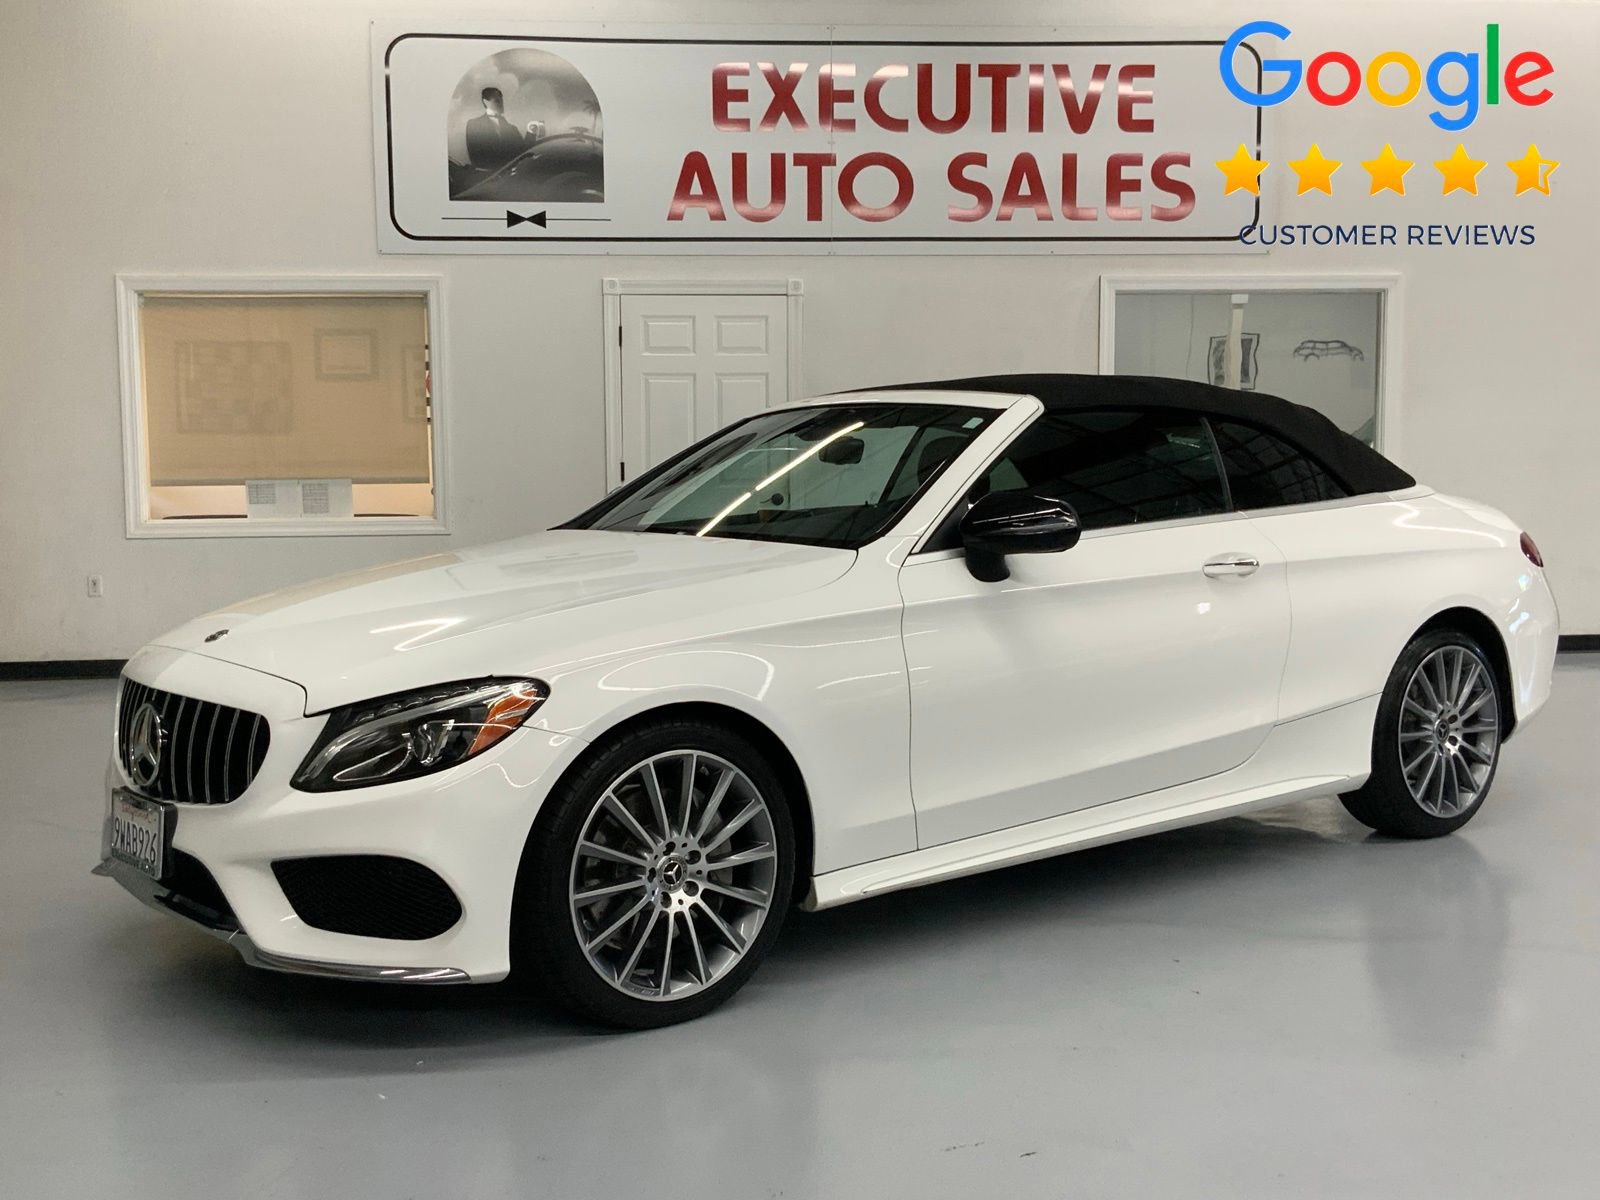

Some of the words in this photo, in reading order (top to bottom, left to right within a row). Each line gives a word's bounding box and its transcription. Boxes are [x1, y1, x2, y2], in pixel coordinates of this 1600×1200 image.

[711, 61, 1156, 135] EXECUTIVE
[667, 150, 915, 224] AUTO
[947, 150, 1197, 224] SALES
